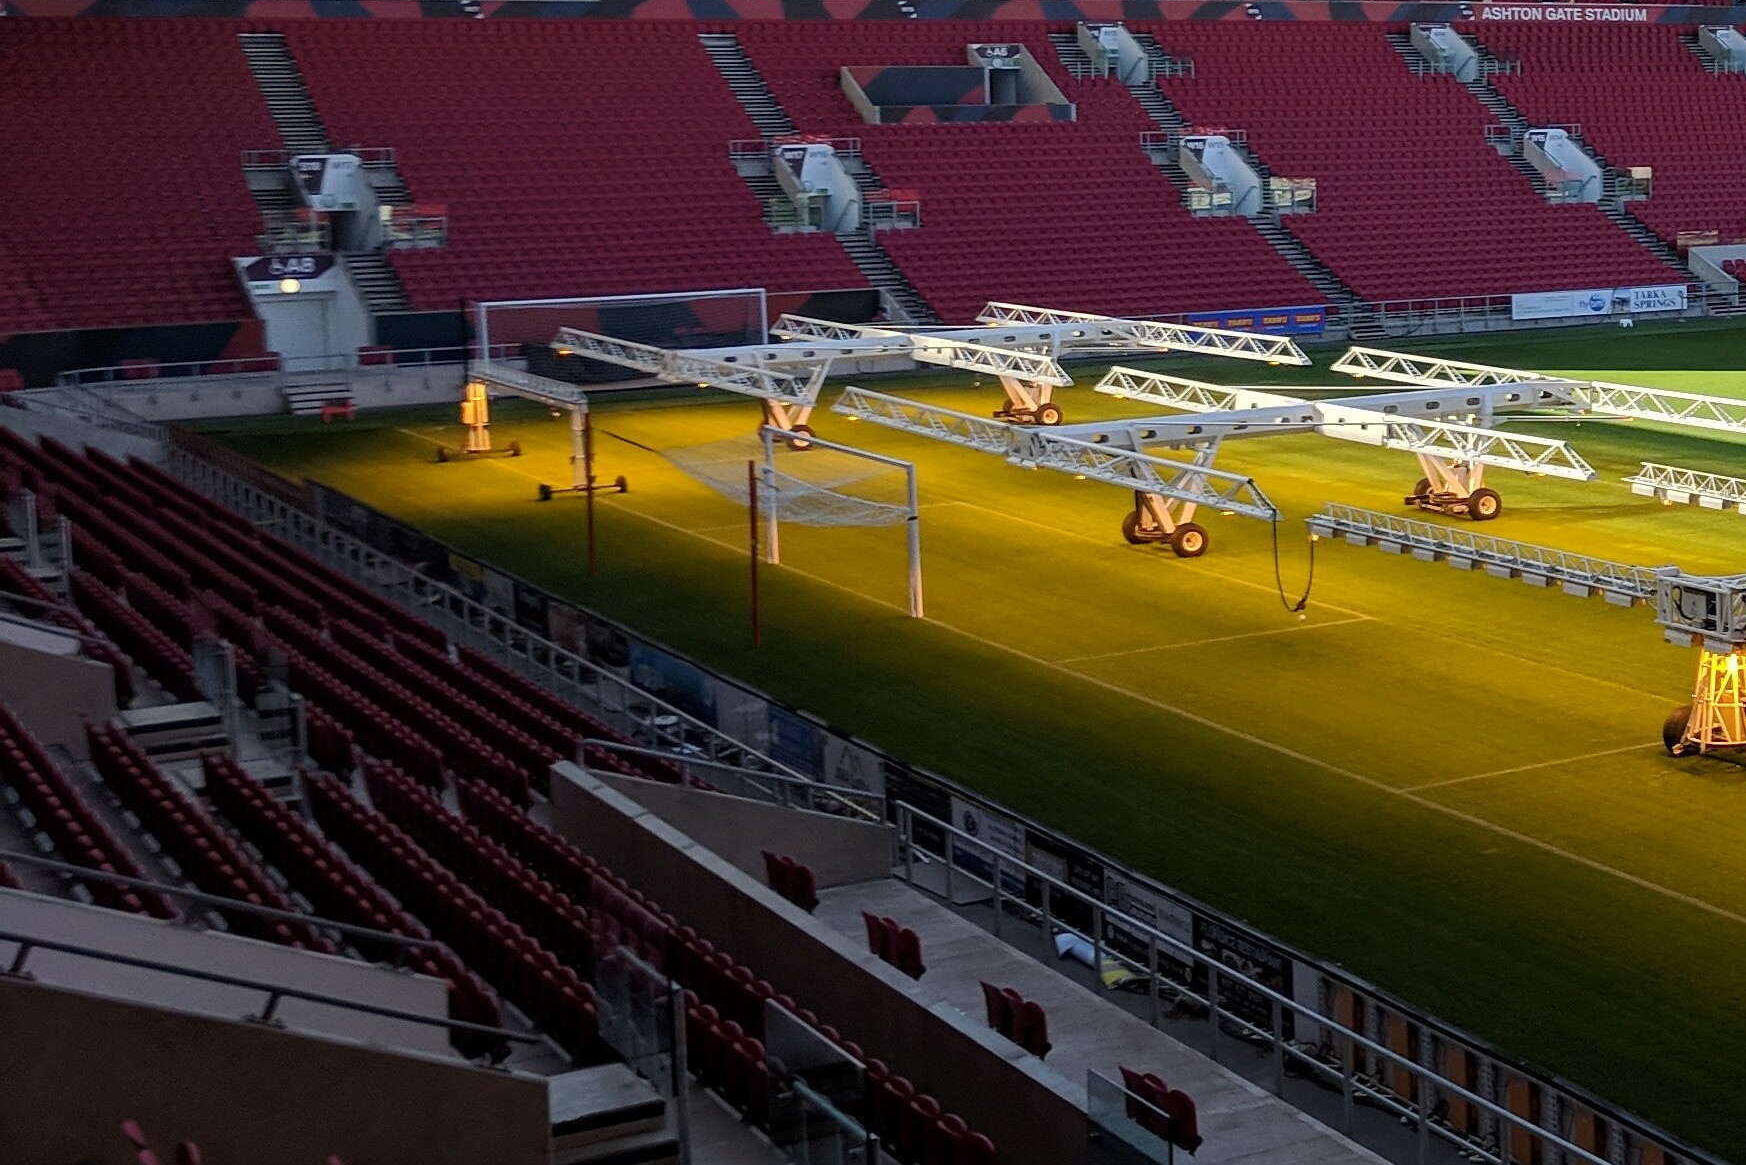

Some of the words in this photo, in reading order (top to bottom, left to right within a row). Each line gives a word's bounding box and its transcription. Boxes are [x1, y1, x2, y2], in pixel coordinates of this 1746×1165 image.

[1481, 6, 1543, 21] ASHTON
[1544, 7, 1583, 21] GATE
[1585, 7, 1648, 22] STADIUM
[1634, 289, 1667, 301] TARKA
[1634, 298, 1676, 310] SPRINGS
